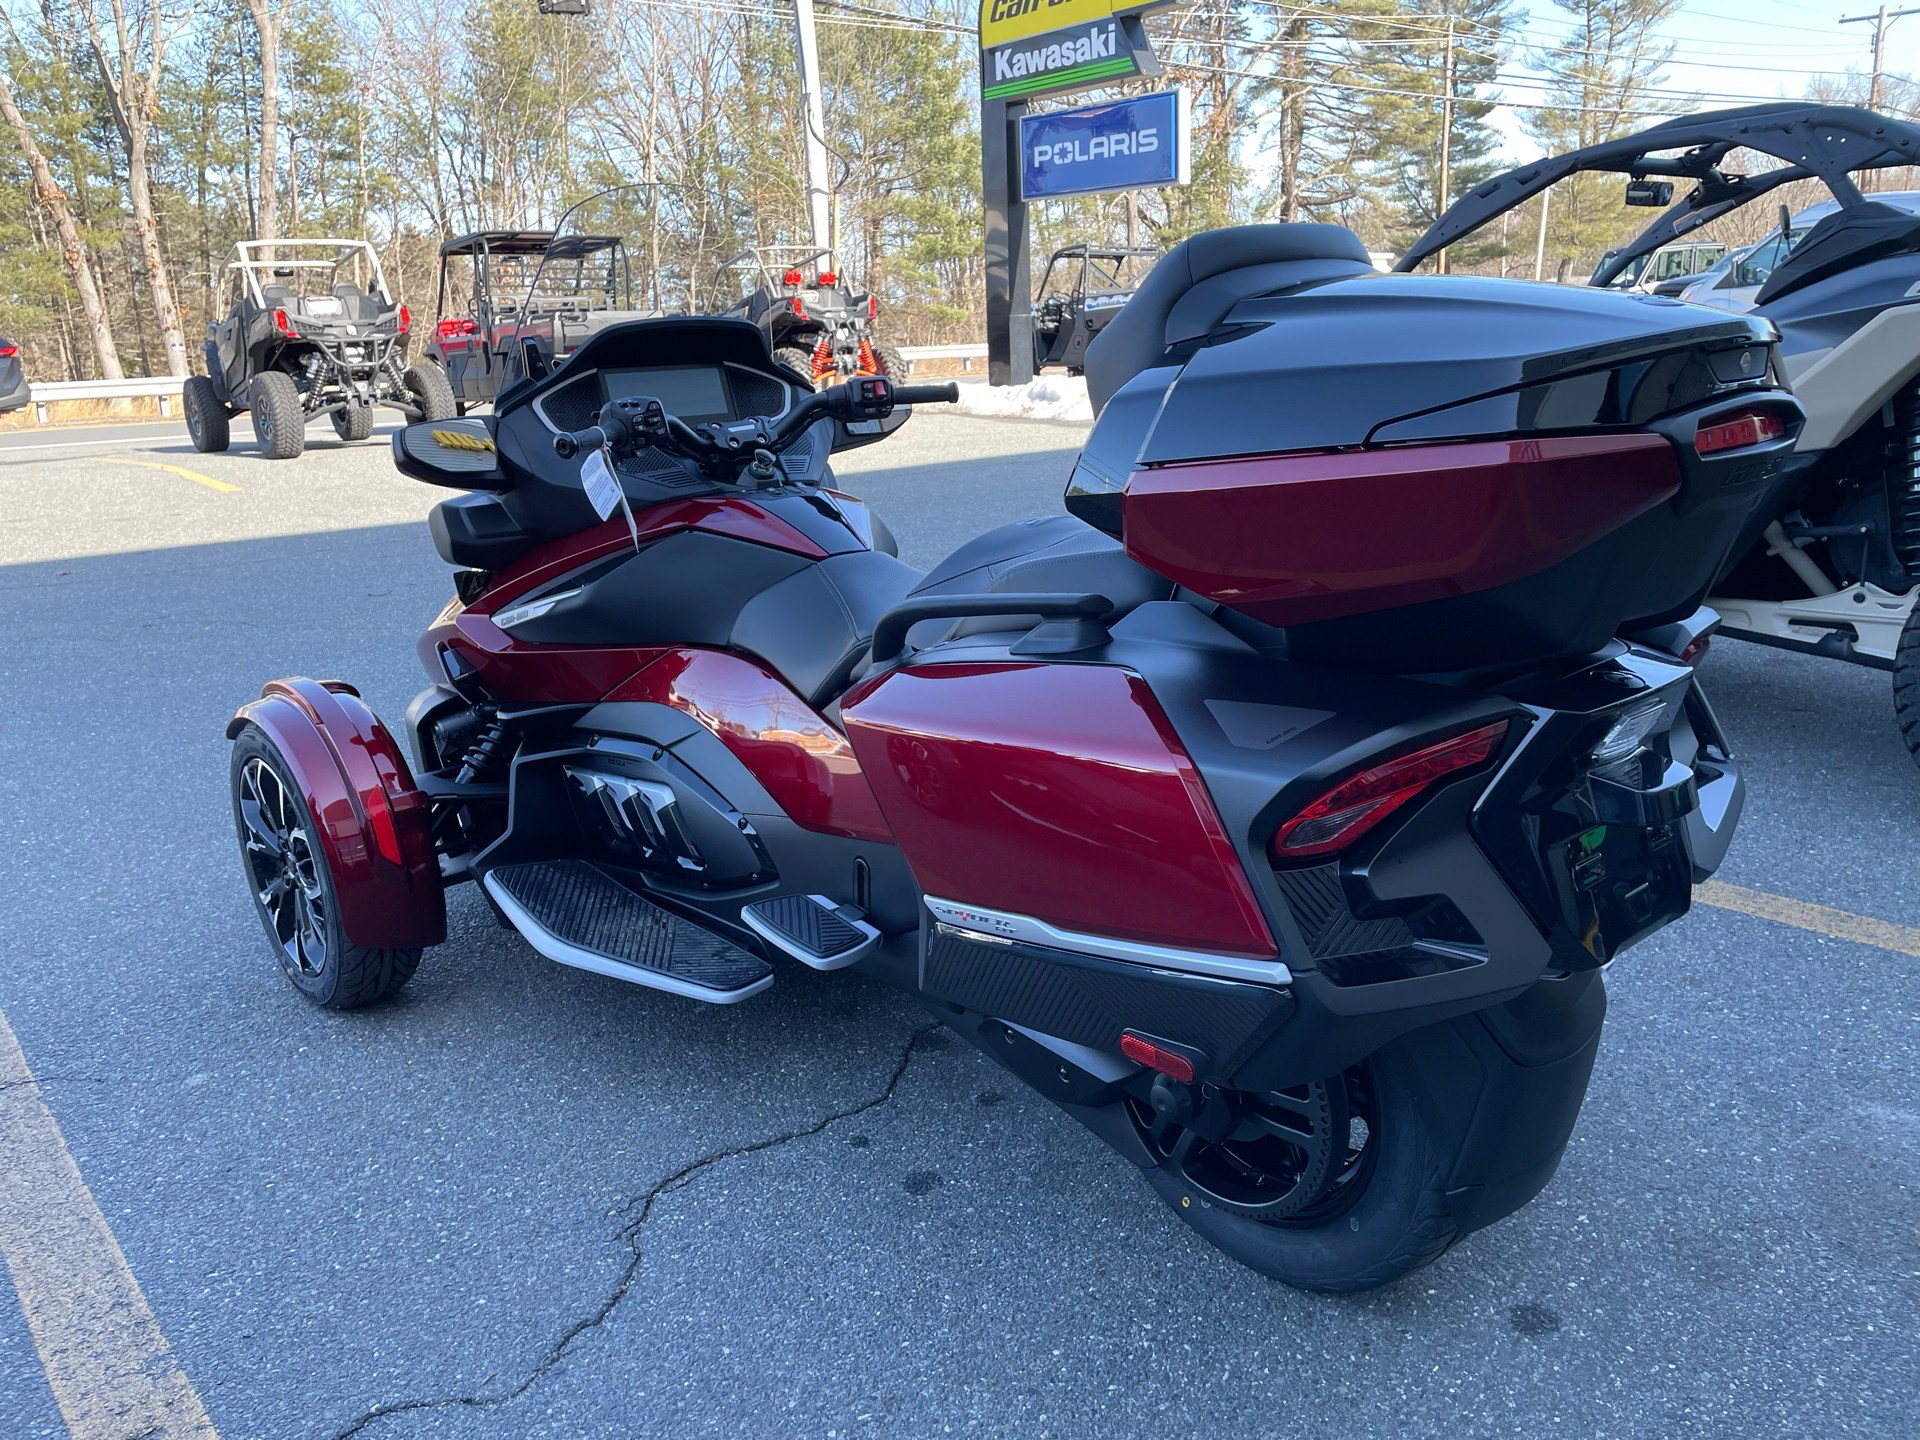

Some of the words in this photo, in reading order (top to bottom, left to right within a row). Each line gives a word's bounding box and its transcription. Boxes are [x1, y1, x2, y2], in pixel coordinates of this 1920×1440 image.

[994, 22, 1116, 81] Kawasaki
[1033, 128, 1159, 168] POLARIS
[500, 610, 529, 627] can-am
[935, 906, 1011, 927] SPYDER
